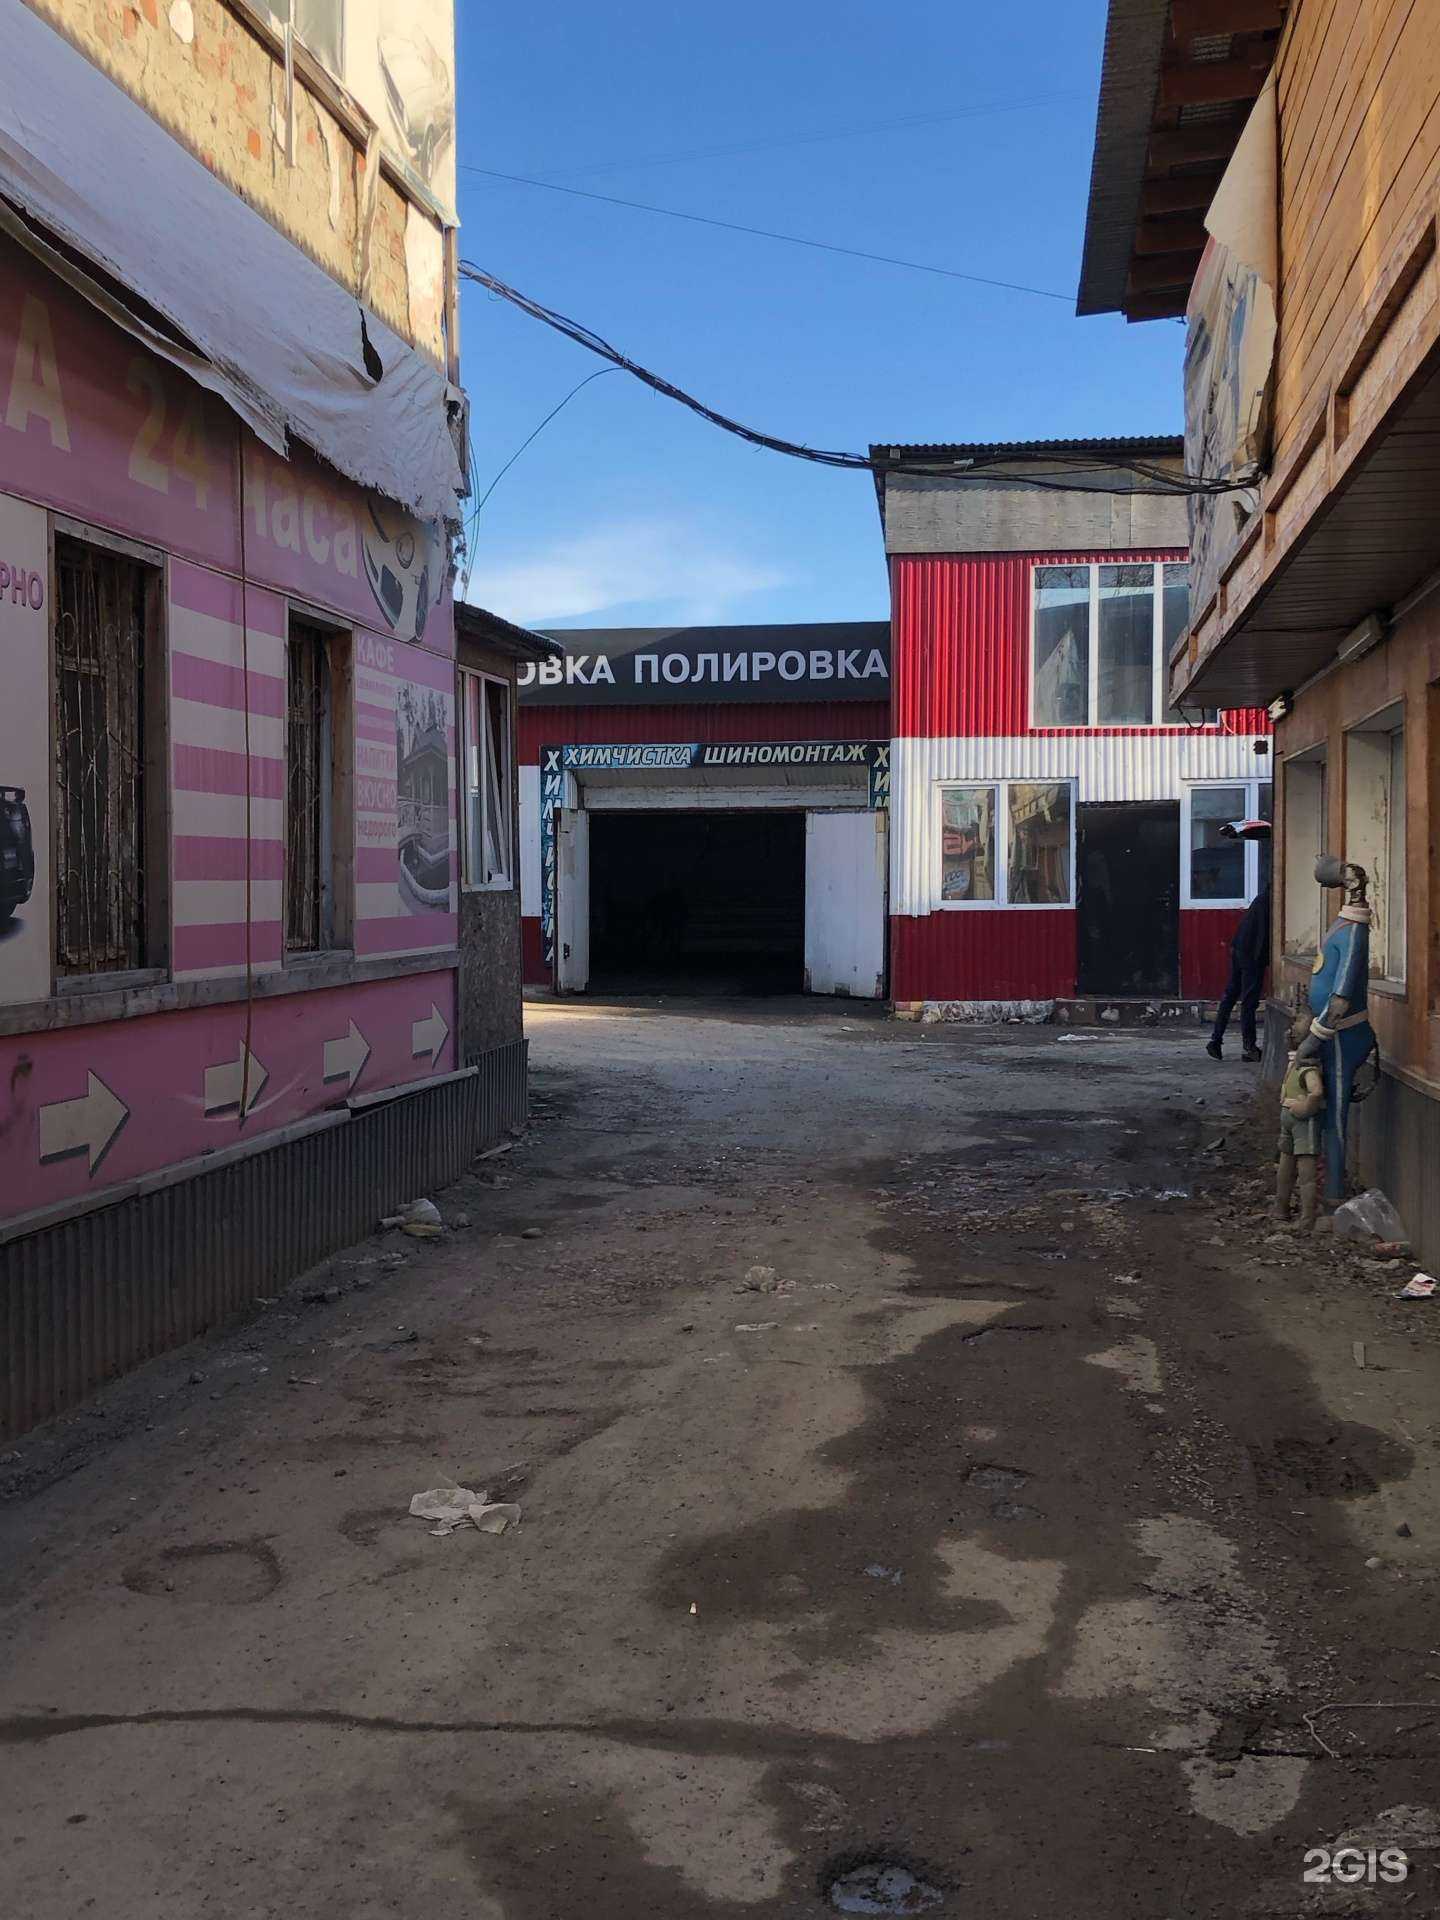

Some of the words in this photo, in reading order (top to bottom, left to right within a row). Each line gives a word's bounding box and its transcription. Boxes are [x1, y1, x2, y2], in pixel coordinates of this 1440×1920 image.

[357, 634, 394, 674] КАФЕ
[634, 648, 889, 683] ПОЛИРОВКА
[564, 746, 692, 765] ХИМЧИСТКА
[704, 744, 867, 764] ШИНОМОНТАЖ
